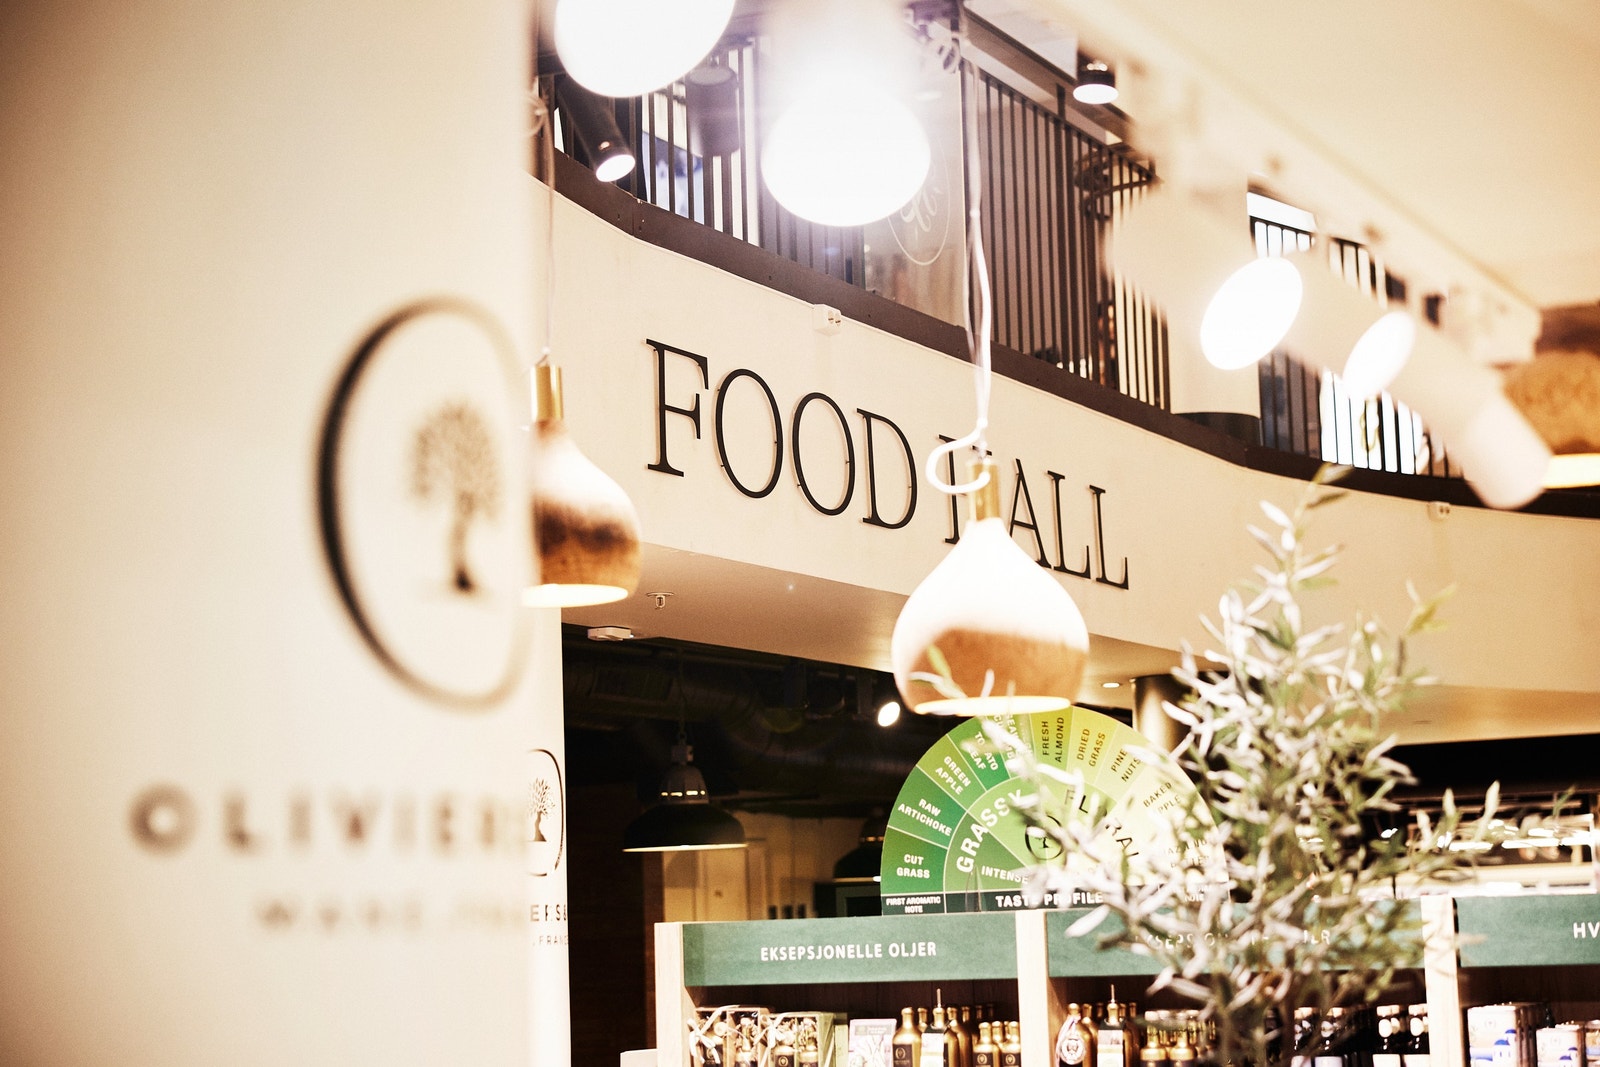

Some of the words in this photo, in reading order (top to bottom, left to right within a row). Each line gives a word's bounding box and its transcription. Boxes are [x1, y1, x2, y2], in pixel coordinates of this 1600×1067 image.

[645, 338, 919, 530] FOOD
[974, 731, 999, 771] TOATO
[1042, 720, 1050, 756] FRESH
[1054, 717, 1065, 763] ALMOND
[1076, 728, 1090, 761] DRIED
[1089, 732, 1106, 768] GRASS
[943, 756, 972, 788] GREEN
[967, 749, 987, 770] EAF
[1110, 748, 1129, 773] PINE
[1121, 757, 1143, 783] NUTS
[935, 767, 964, 795] APPLE
[918, 799, 941, 817] RAW
[1143, 782, 1172, 808] BAKED
[1157, 794, 1182, 815] PPLE
[897, 803, 953, 837] ARTICHOKE
[956, 789, 1023, 874] GRASSY
[903, 854, 924, 865] CUT
[896, 867, 931, 879] GRASS
[981, 865, 1030, 885] INTENSE
[886, 898, 905, 906] FIRST
[906, 896, 941, 905] AROMATIC
[904, 905, 924, 914] NOTE
[995, 894, 1039, 908] TAST
[1043, 892, 1104, 905] PRFILE
[760, 943, 883, 961] EKSEPSJONELLE
[888, 941, 937, 957] OLJER
